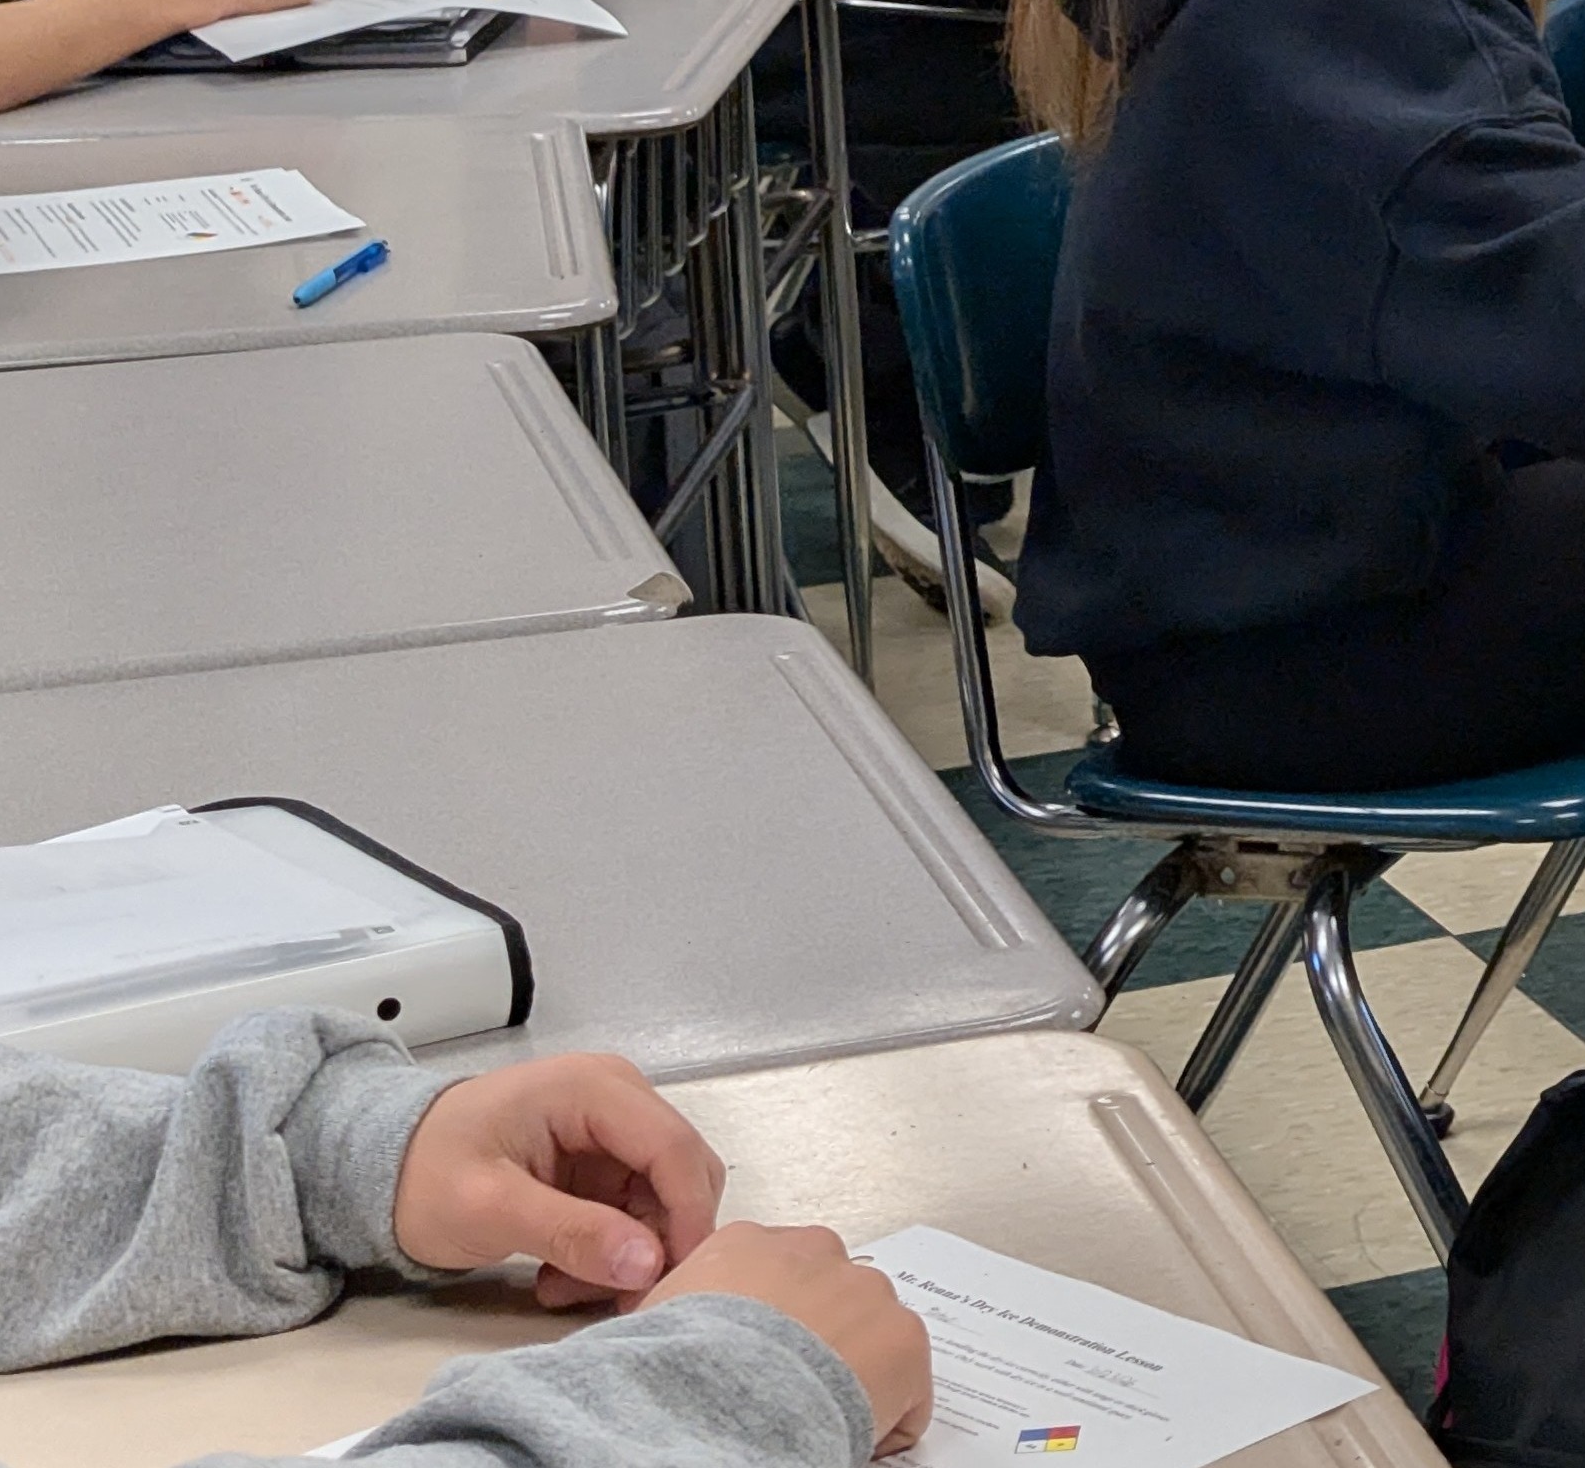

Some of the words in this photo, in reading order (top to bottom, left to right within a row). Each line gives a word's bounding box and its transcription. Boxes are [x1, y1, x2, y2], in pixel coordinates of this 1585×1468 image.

[895, 1270, 916, 1284] Mr.
[970, 1298, 997, 1315] Dry
[997, 1308, 1020, 1323] Ice
[1018, 1315, 1116, 1356] Demonstration
[1116, 1349, 1164, 1373] Lesson
